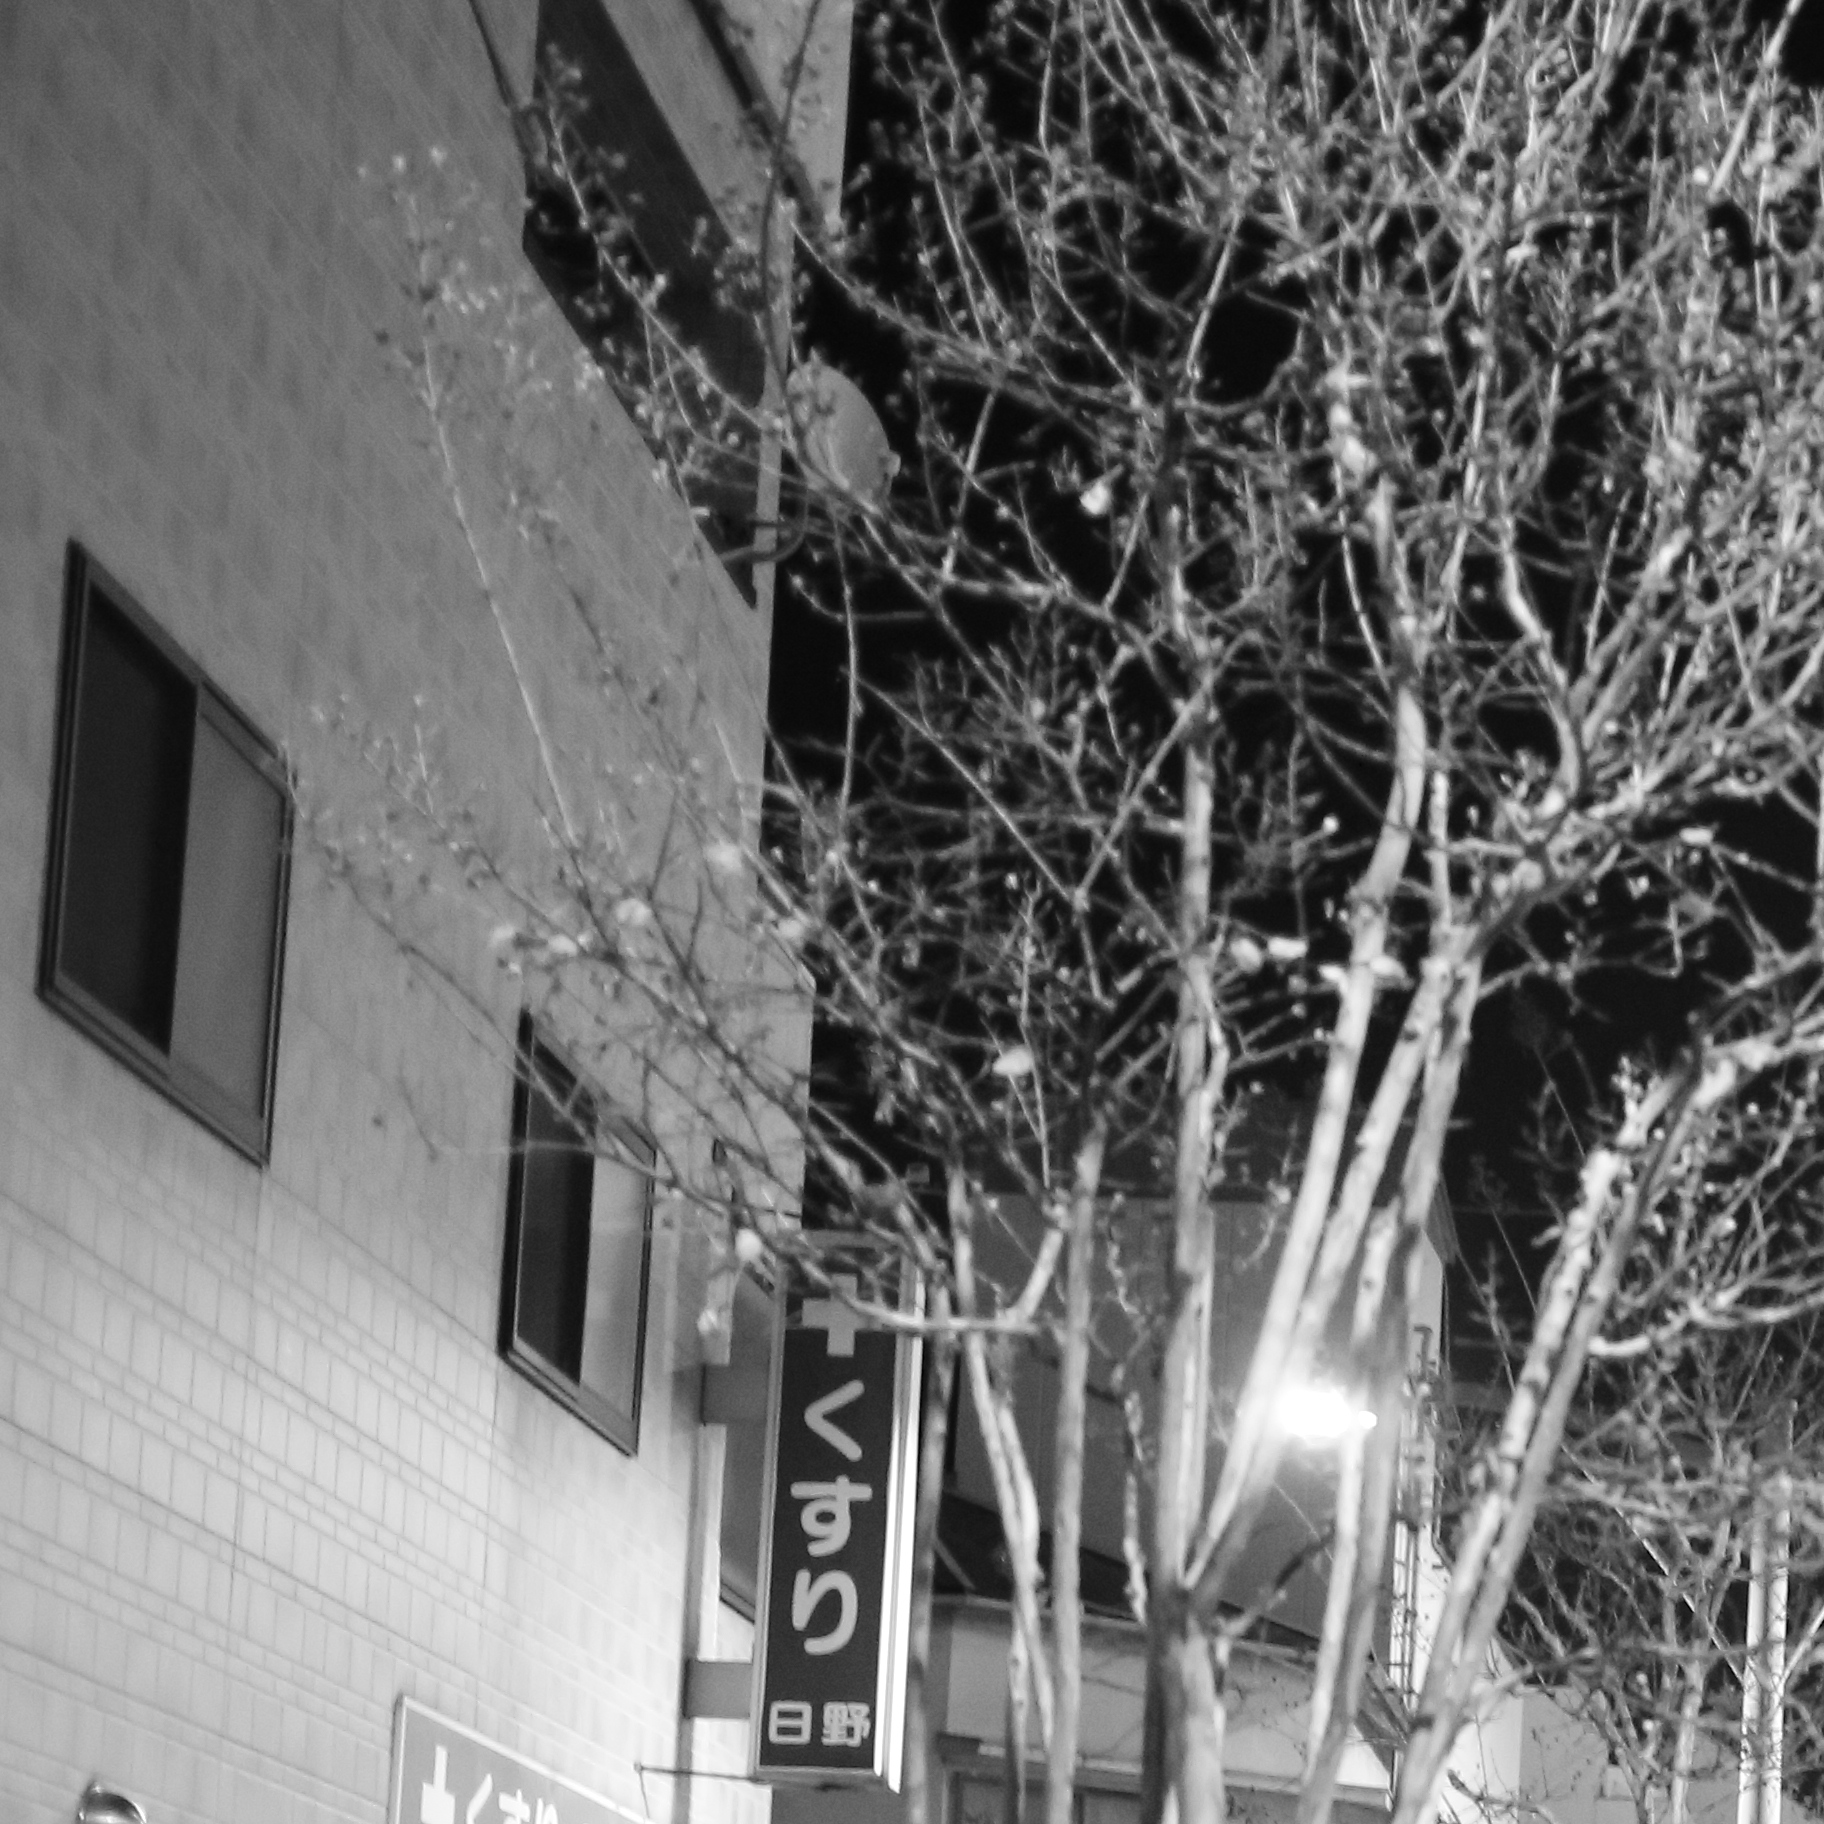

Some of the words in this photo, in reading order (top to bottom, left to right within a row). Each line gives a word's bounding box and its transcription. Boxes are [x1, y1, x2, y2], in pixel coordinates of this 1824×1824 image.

[790, 1379, 872, 1655] くすり
[768, 1700, 870, 1748] 日野
